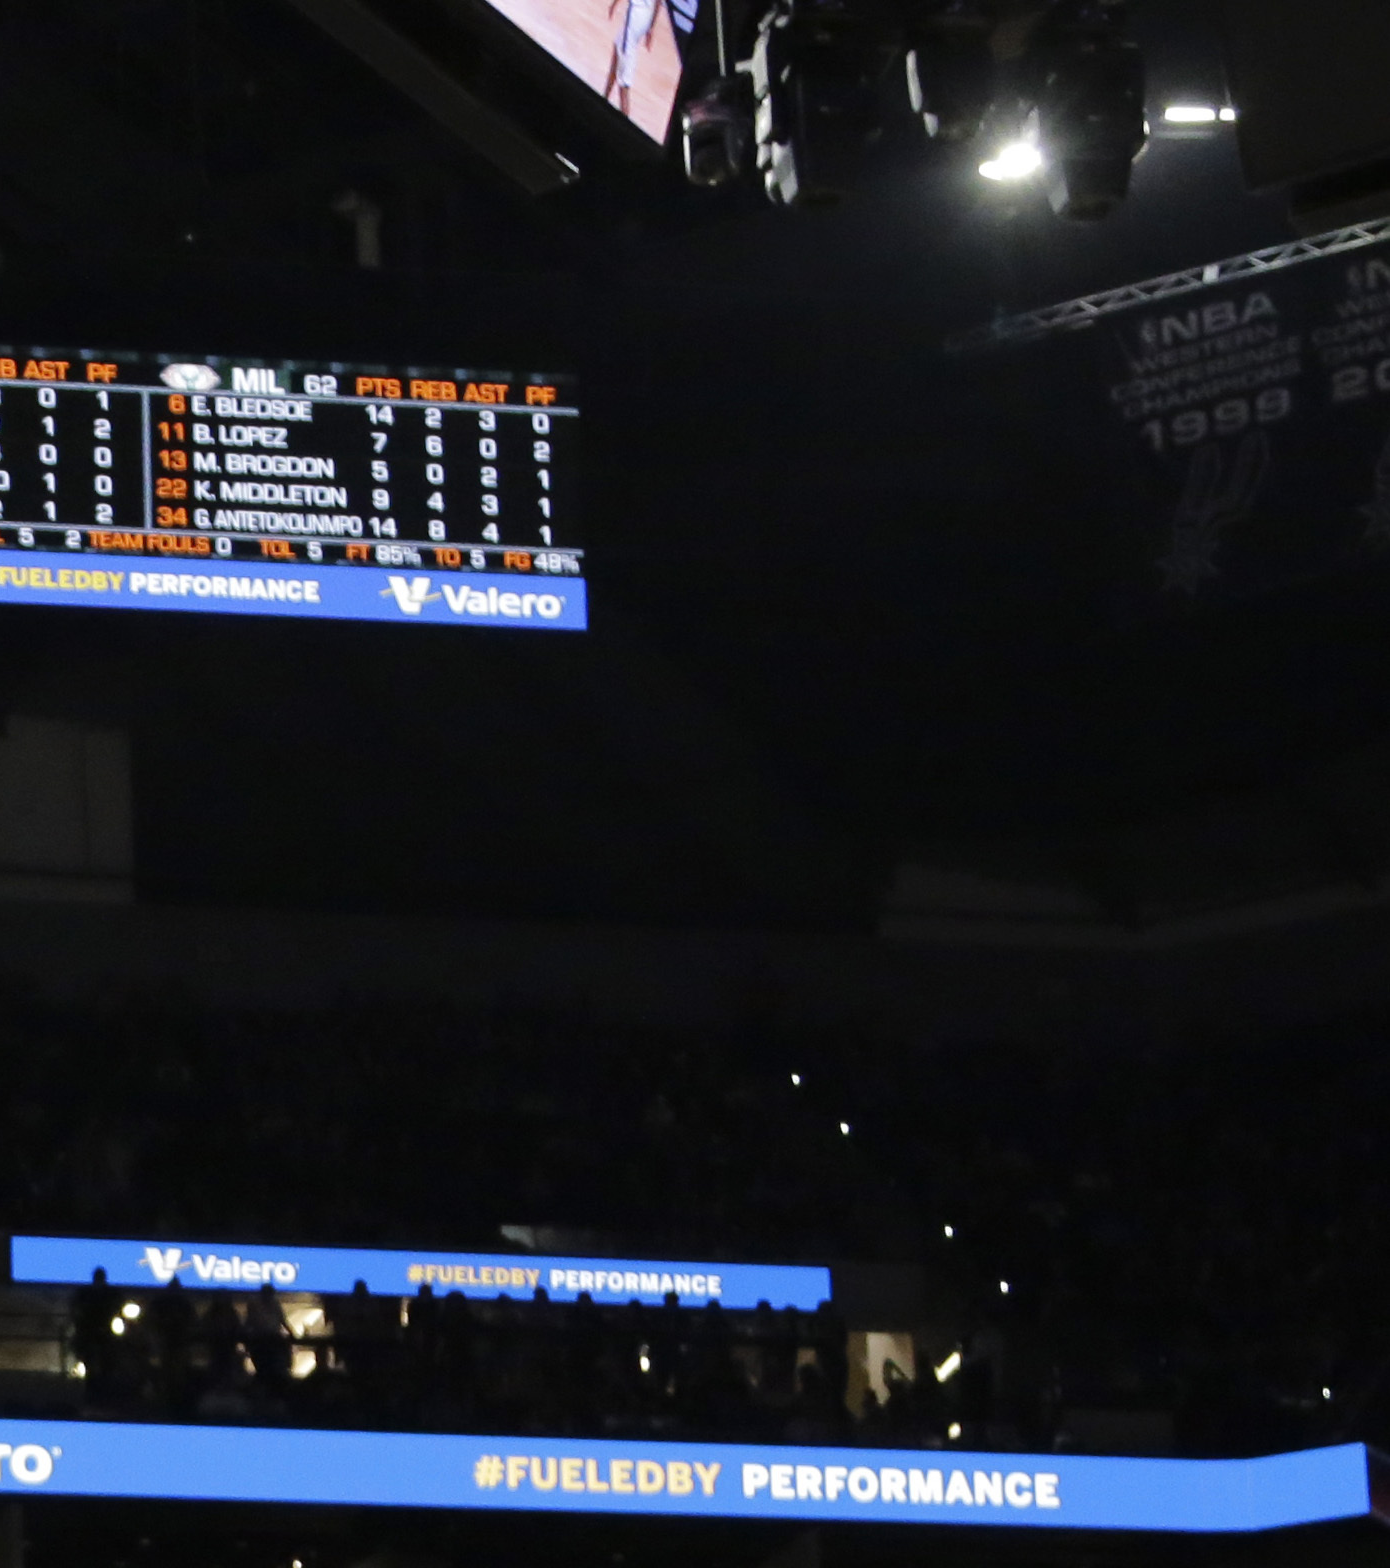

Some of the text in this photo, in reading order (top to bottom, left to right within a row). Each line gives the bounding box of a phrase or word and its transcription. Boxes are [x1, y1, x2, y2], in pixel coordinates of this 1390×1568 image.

[1160, 291, 1278, 345] NBA
[24, 360, 70, 381] AST
[87, 362, 118, 383] PF
[232, 367, 556, 406] MIL 62 PTS REB AST PF
[38, 387, 57, 408] 0
[96, 391, 109, 411] 1
[168, 394, 550, 434] 6 E. BLEDSOE 14 2 3 0
[42, 416, 54, 437] 1
[93, 418, 111, 440] 2
[1140, 388, 1291, 452] 1999
[38, 444, 57, 465] 0
[94, 447, 112, 468] 0
[158, 422, 550, 463] 11 B. LOPEZ 7 6 0 2
[42, 473, 55, 493] 1
[94, 475, 113, 496] 0
[158, 450, 550, 490] 13 M. BROGDON 5 0 2 1
[43, 501, 56, 521] 1
[95, 503, 113, 525] 2
[155, 478, 550, 518] 22 K. MIDDLETON 9 4 3 1
[156, 506, 187, 527] 34
[369, 518, 397, 538] 14
[428, 520, 446, 541] 8
[482, 522, 499, 544] 4
[539, 525, 552, 546] 1
[18, 528, 35, 547] 5
[65, 530, 81, 549] 2
[87, 532, 143, 549] TEAM
[146, 536, 211, 554] FOULS
[215, 538, 232, 556] 0
[307, 542, 323, 561] 5
[346, 544, 370, 561] FT
[375, 545, 422, 566] 85%
[470, 550, 485, 569] 5
[504, 551, 531, 570] FG
[534, 553, 580, 574] 48%
[130, 571, 321, 604] PERFORMANCE
[442, 584, 563, 619] Valero
[191, 1253, 297, 1284] Valero
[407, 1262, 722, 1296] #FUELEDBY PERFORMANCE
[474, 1454, 1060, 1509] #FUELEDBY PERFORMANCE
